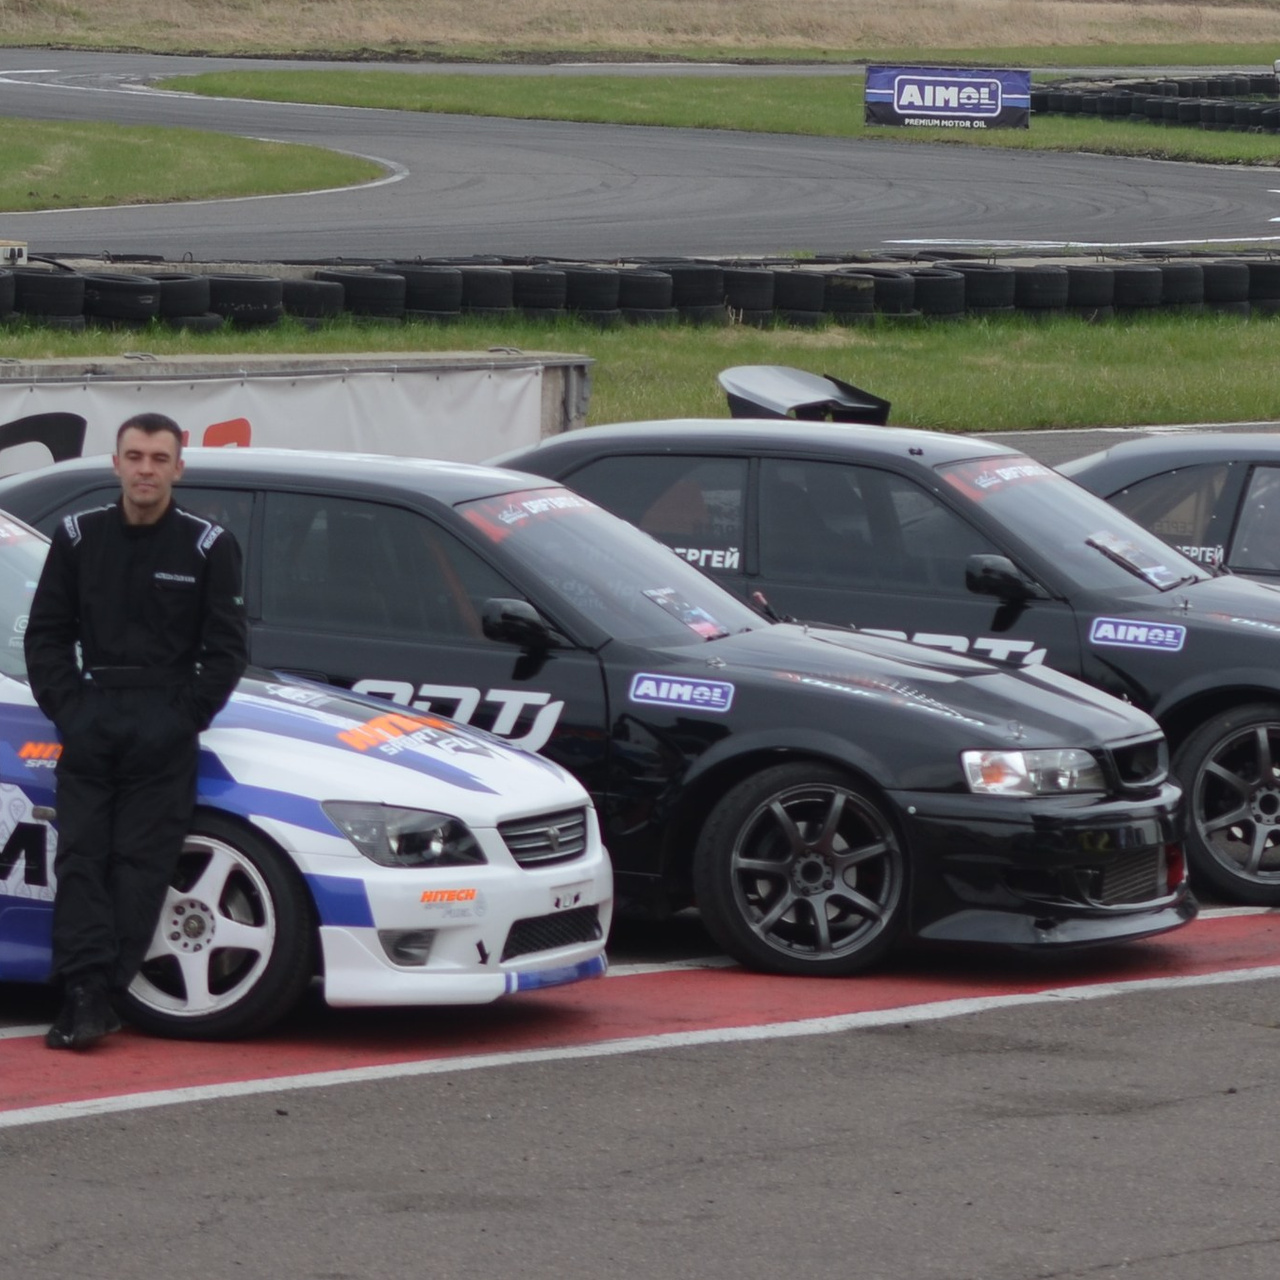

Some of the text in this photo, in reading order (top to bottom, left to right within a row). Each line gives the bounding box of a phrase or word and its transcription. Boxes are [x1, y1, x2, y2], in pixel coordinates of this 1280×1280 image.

[899, 84, 997, 109] AIMOL
[904, 117, 988, 129] PREMIUM MOTOR OIL
[1175, 544, 1225, 563] ЕРГЕЙ
[1094, 623, 1179, 646] AIMOL
[634, 679, 727, 706] AIMOL
